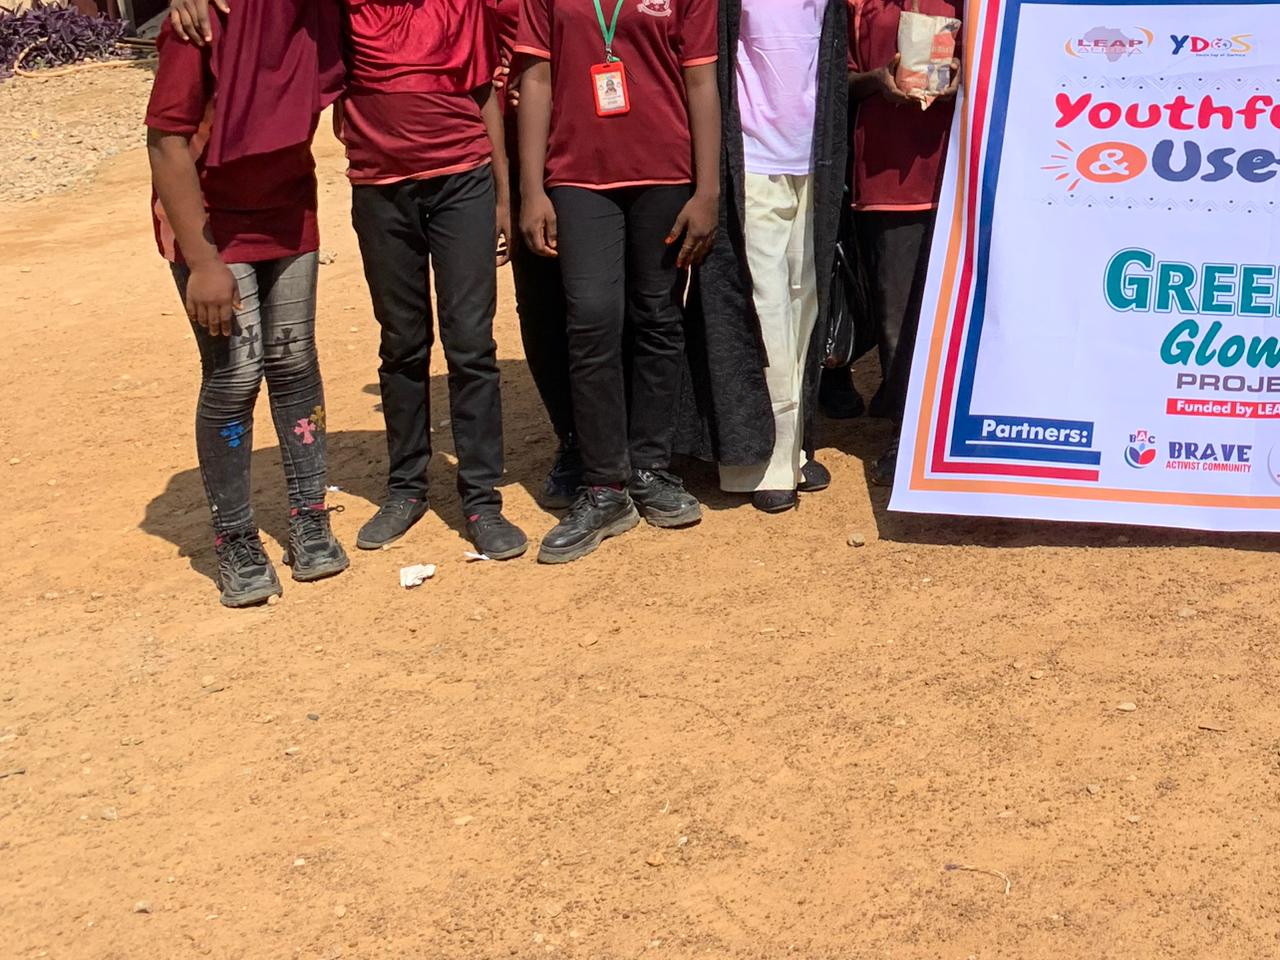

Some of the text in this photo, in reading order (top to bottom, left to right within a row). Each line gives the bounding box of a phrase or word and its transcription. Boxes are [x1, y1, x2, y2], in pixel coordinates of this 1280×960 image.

[1078, 39, 1144, 48] LEAP
[1089, 148, 1131, 177] &
[1176, 400, 1231, 415] Funded
[1235, 402, 1253, 418] by
[981, 419, 1089, 444] Partners:
[1168, 441, 1252, 463] BRAVE
[1165, 460, 1252, 473] ACTIVIST COMMUNITY
